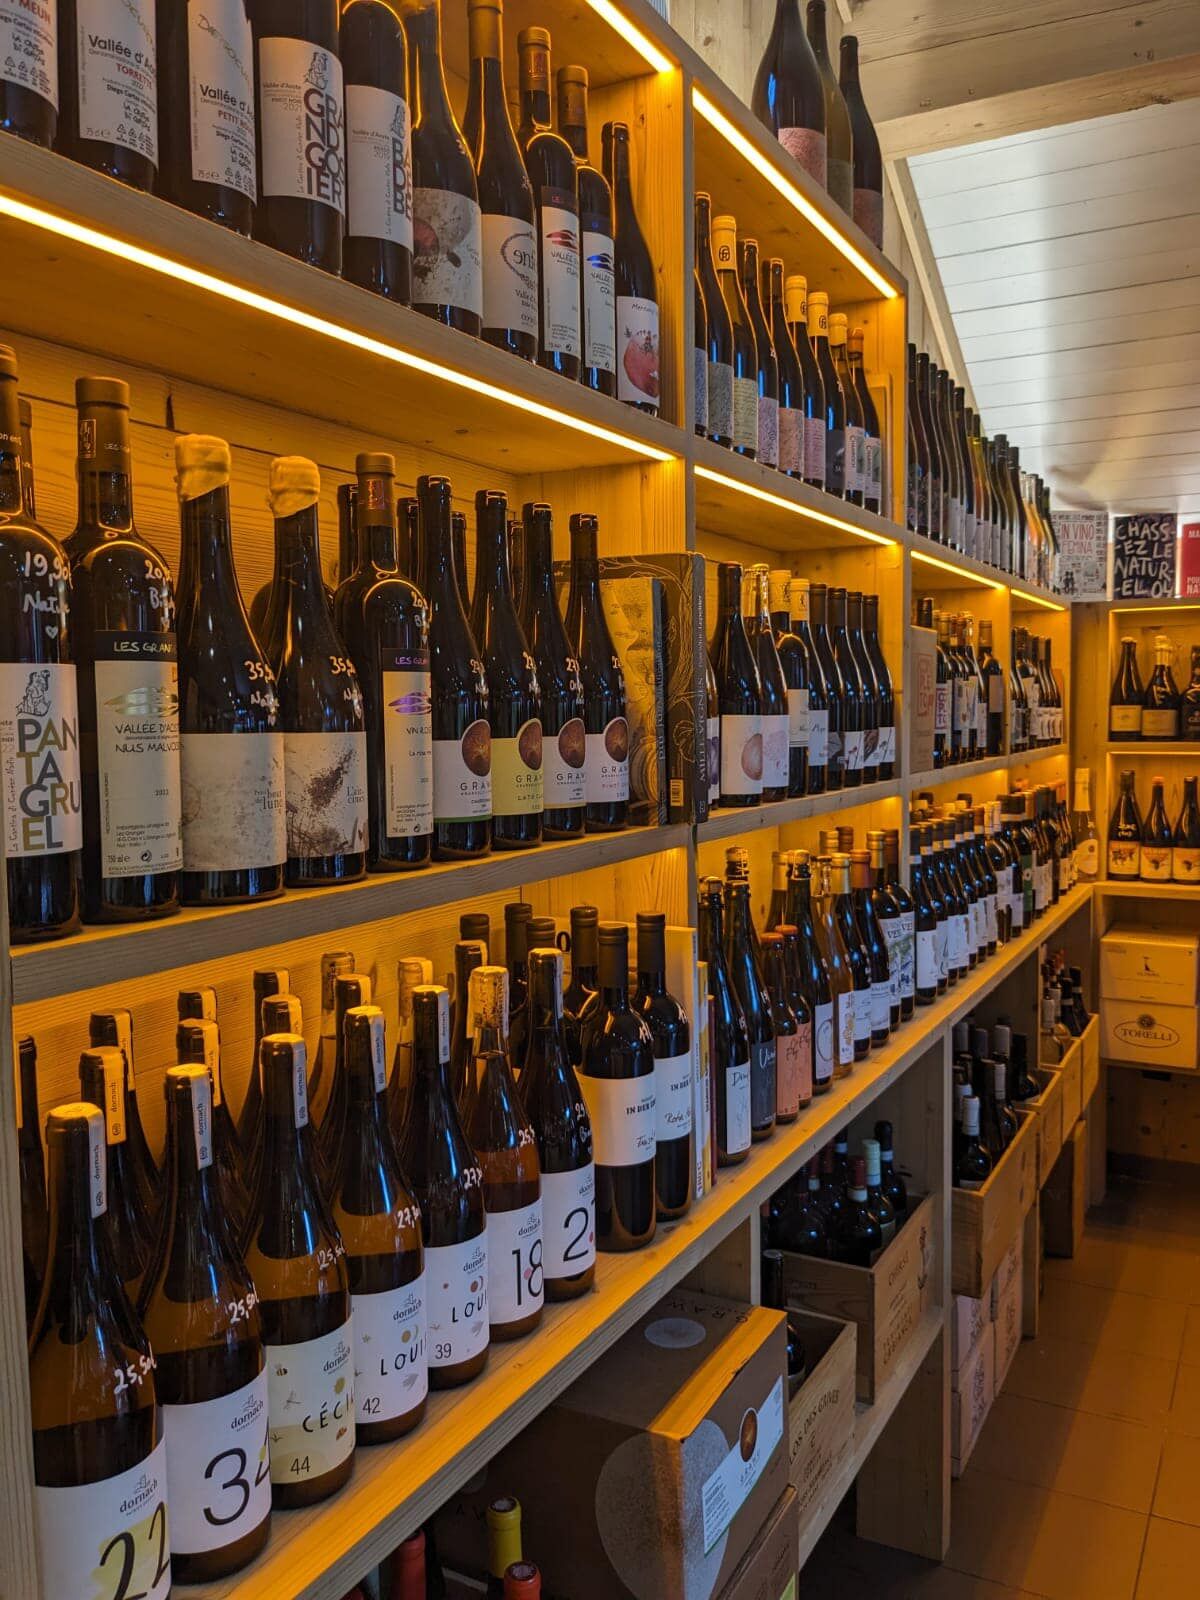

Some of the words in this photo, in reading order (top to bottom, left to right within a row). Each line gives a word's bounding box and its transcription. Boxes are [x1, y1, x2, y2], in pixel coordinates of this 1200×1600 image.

[88, 34, 132, 58] Vallée
[200, 84, 237, 106] Vallée
[1061, 524, 1070, 540] IN
[1073, 524, 1094, 540] VINO
[1153, 543, 1172, 558] LE
[113, 641, 139, 653] LES
[395, 656, 412, 665] LES
[697, 677, 707, 735] VIGNES
[17, 716, 78, 753] PAN
[405, 727, 418, 735] VIN
[16, 750, 64, 785] TA
[19, 780, 81, 818] GRU
[22, 815, 64, 852] EL
[1121, 1026, 1173, 1042] TORELLI
[670, 1083, 680, 1092] IN
[626, 1105, 636, 1116] IN
[512, 1239, 543, 1306] 18
[435, 1342, 452, 1360] 39
[230, 1400, 264, 1430] dornach
[362, 1396, 381, 1415] 42
[290, 1455, 312, 1475] 44
[119, 1479, 158, 1514] dornach
